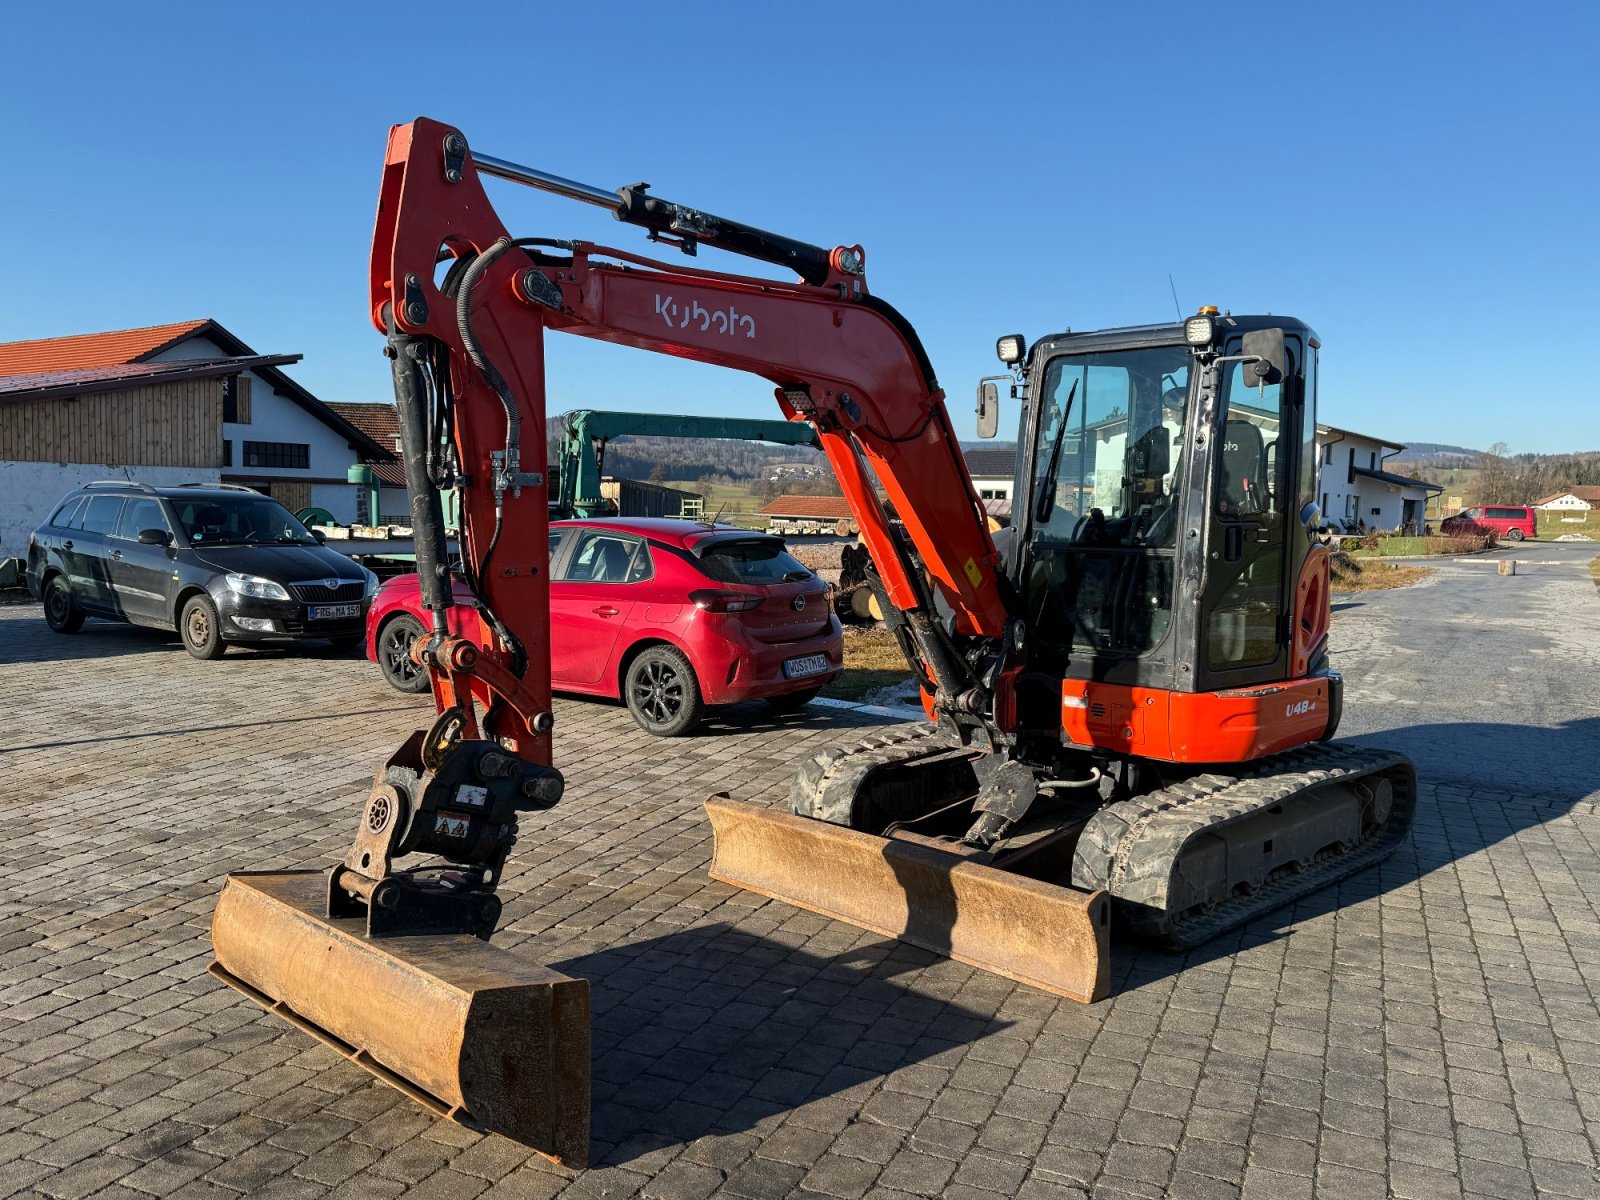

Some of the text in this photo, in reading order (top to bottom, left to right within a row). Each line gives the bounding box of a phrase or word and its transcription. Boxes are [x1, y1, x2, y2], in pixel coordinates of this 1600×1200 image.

[655, 294, 755, 338] Kubota
[315, 605, 360, 618] FRG MA 159
[788, 659, 804, 674] WOS
